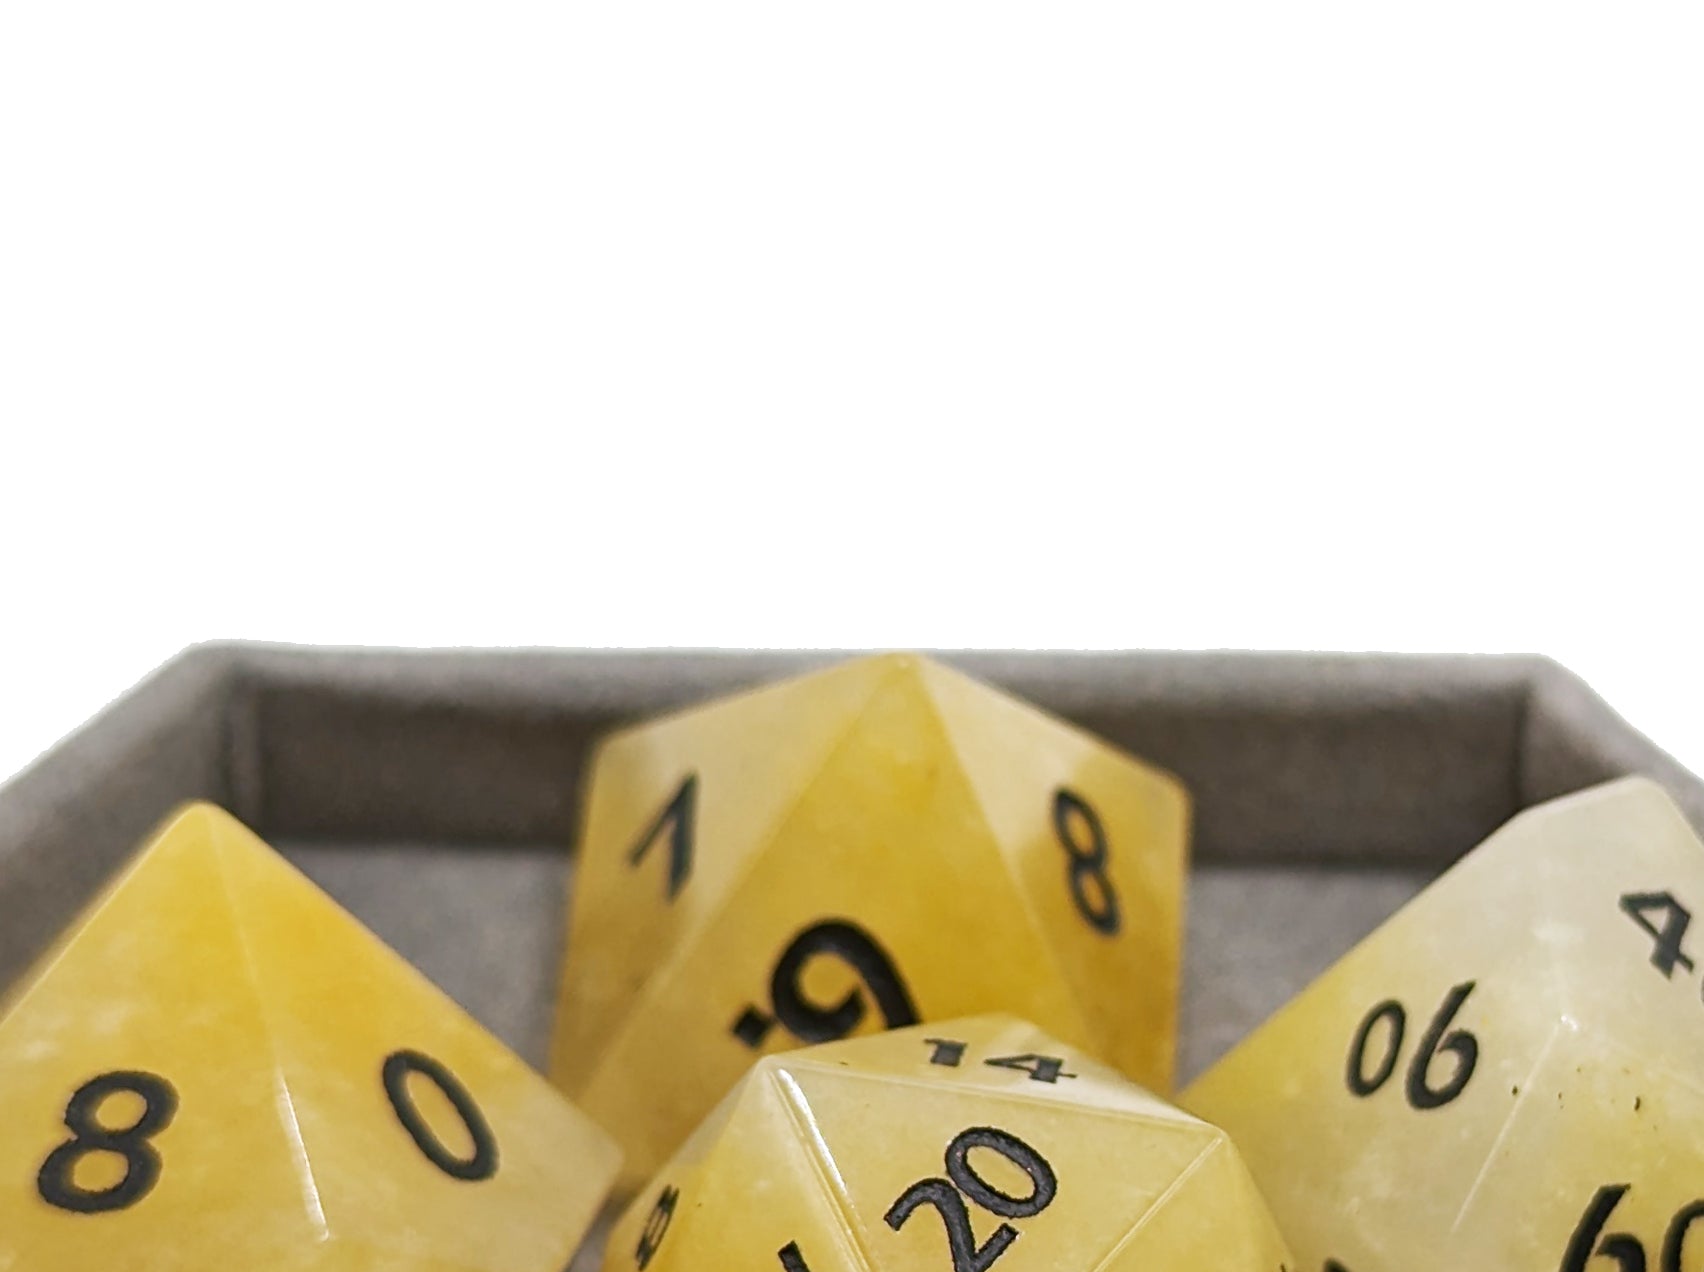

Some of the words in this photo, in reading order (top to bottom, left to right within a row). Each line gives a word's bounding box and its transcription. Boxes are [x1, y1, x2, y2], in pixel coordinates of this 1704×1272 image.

[630, 773, 699, 904] 1
[1053, 788, 1121, 936] 8
[1618, 889, 1704, 1008] 4
[381, 1048, 499, 1182] 0
[923, 1037, 1079, 1085] 14
[37, 1069, 180, 1214] 8
